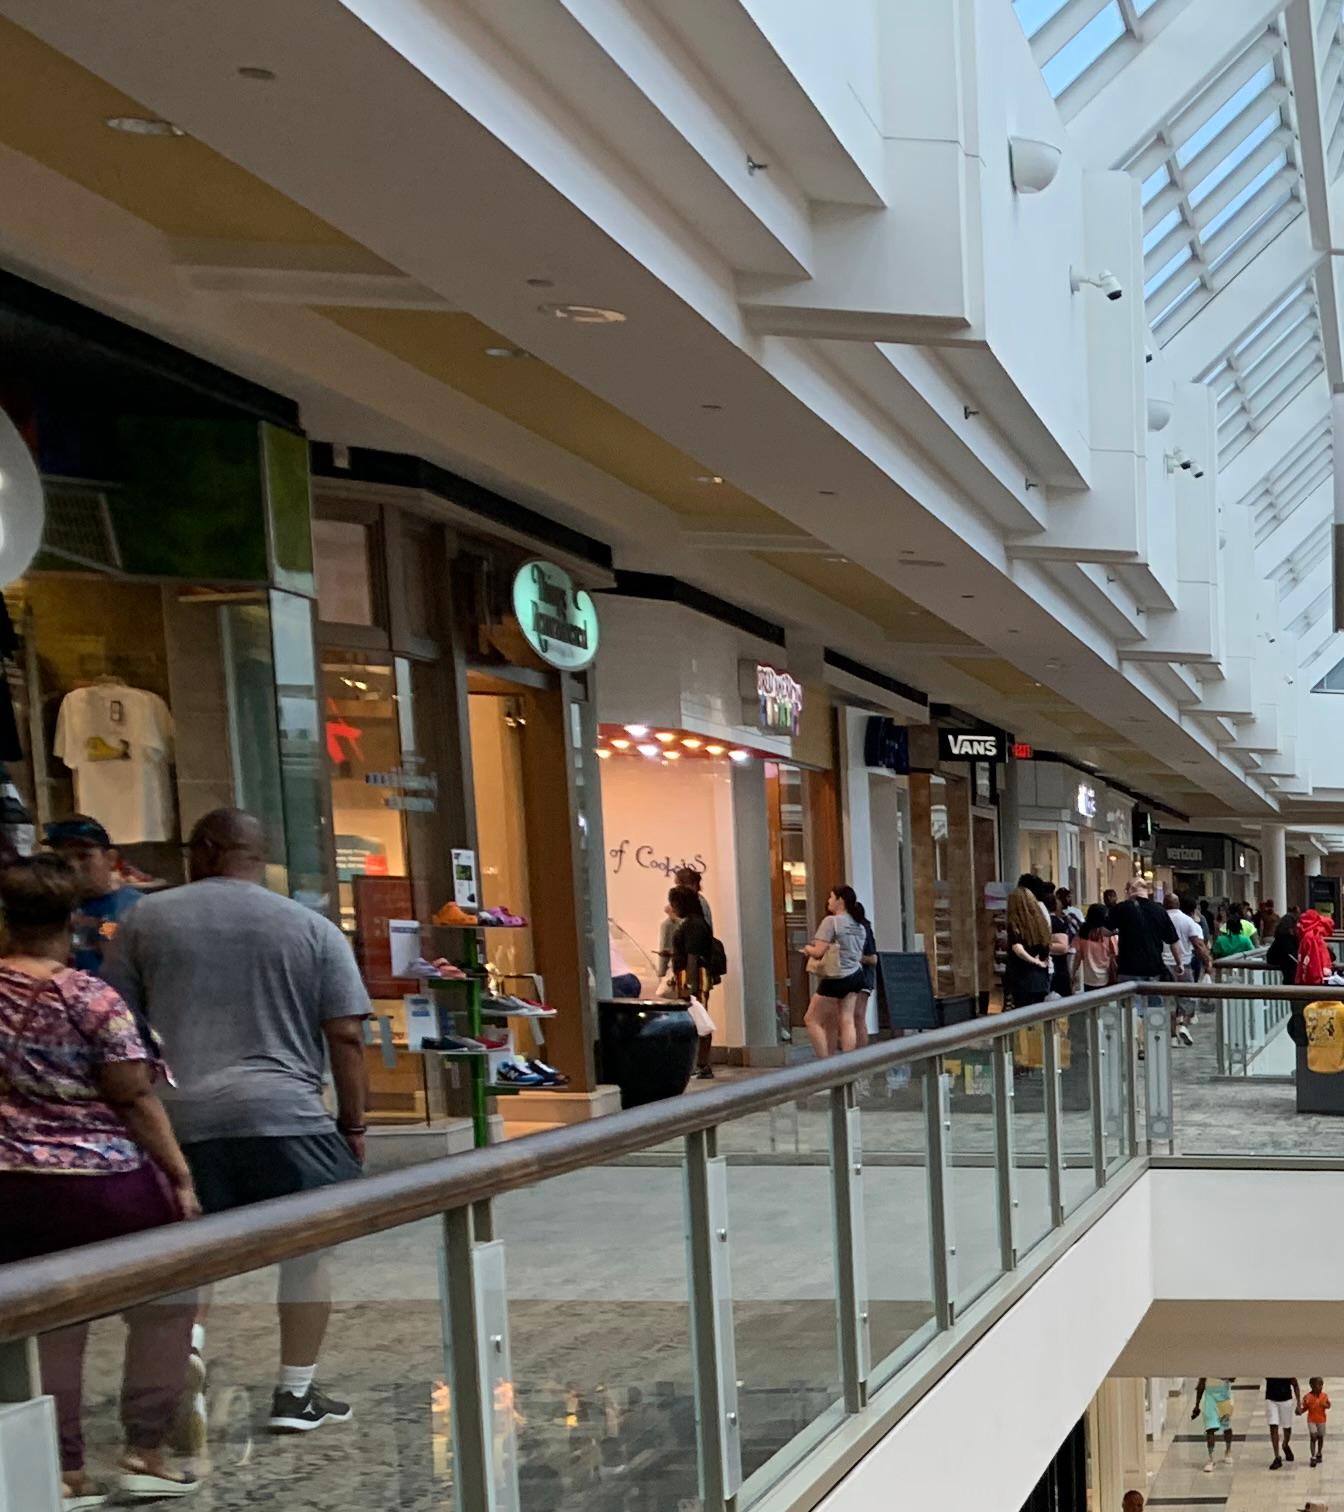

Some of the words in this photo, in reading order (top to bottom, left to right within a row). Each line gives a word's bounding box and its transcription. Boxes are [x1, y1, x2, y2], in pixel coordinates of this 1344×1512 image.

[948, 734, 998, 756] VANS
[610, 840, 630, 874] of
[1166, 846, 1203, 861] verizon
